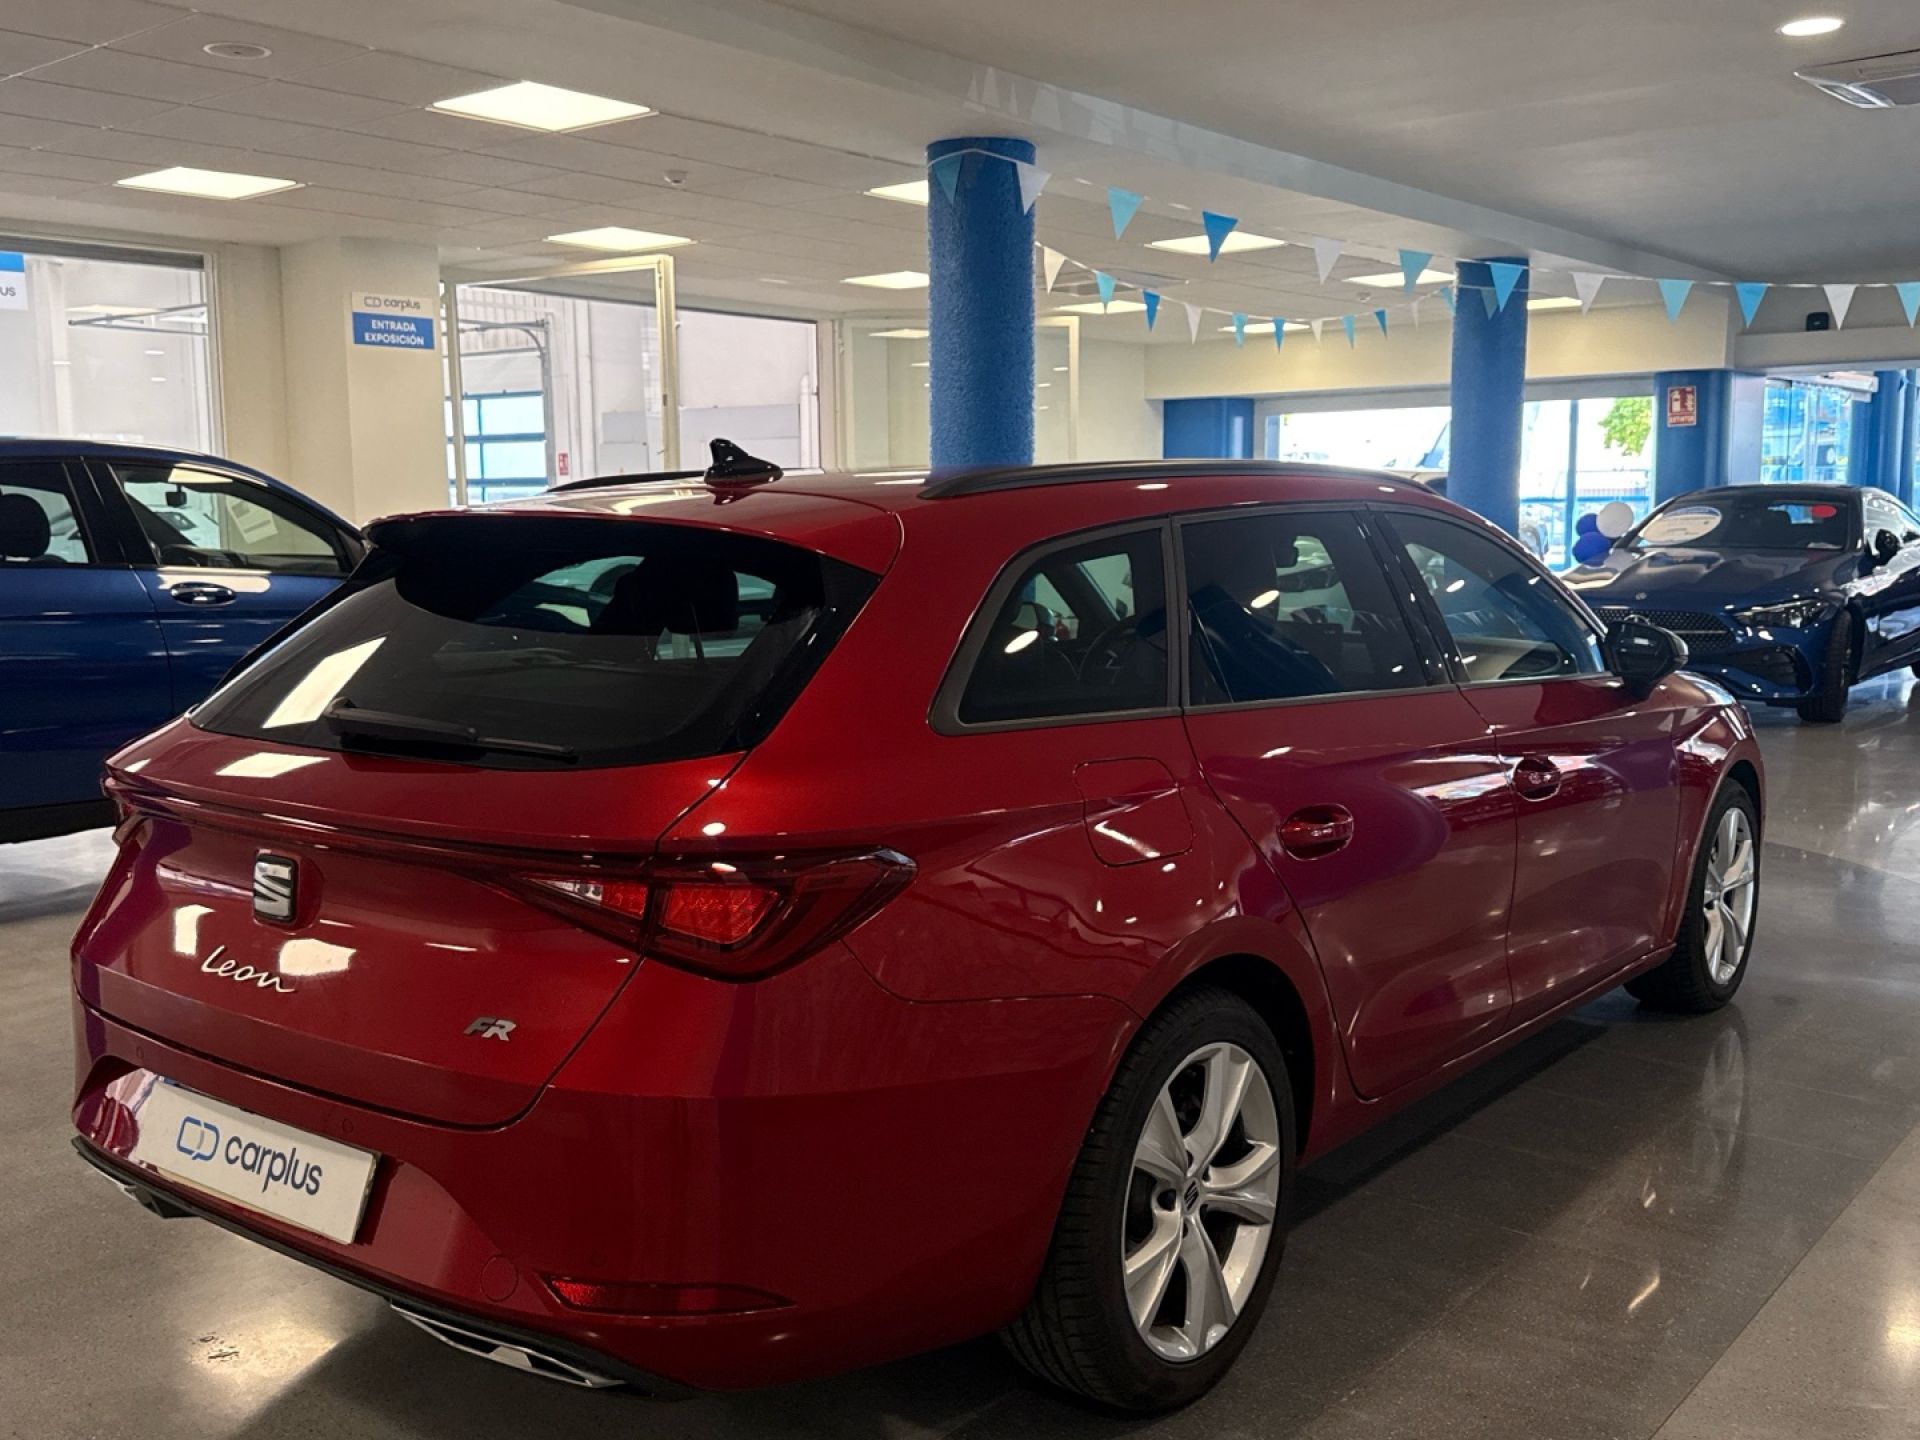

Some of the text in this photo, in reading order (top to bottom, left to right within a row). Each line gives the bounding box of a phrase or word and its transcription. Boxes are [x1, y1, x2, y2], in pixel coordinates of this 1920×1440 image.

[384, 298, 421, 311] carplus
[371, 319, 417, 332] ENTRADA
[364, 331, 425, 345] EXPOSICIÓN
[201, 945, 295, 992] Leon
[463, 1016, 517, 1041] FR
[225, 1135, 322, 1195] carplus
